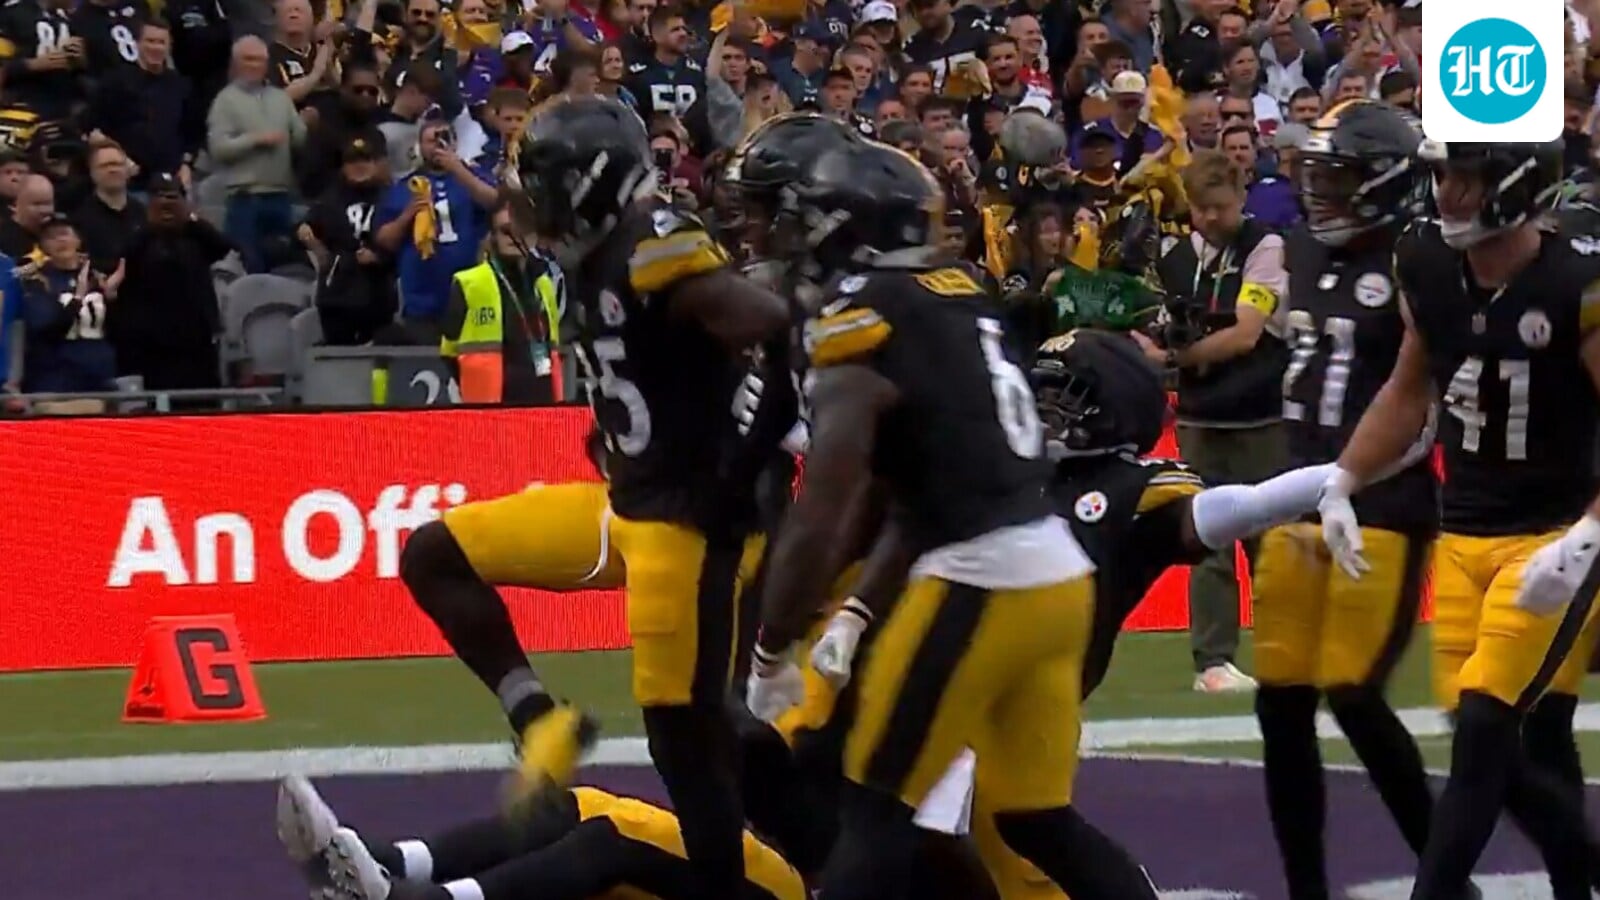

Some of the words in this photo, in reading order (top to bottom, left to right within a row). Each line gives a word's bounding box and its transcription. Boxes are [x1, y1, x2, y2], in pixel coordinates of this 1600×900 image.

[574, 338, 651, 456] 5
[976, 317, 1044, 459] 6
[1282, 311, 1356, 427] 21
[1444, 356, 1530, 460] 41
[106, 496, 255, 587] An
[282, 483, 467, 581] Off
[175, 628, 245, 709] G
